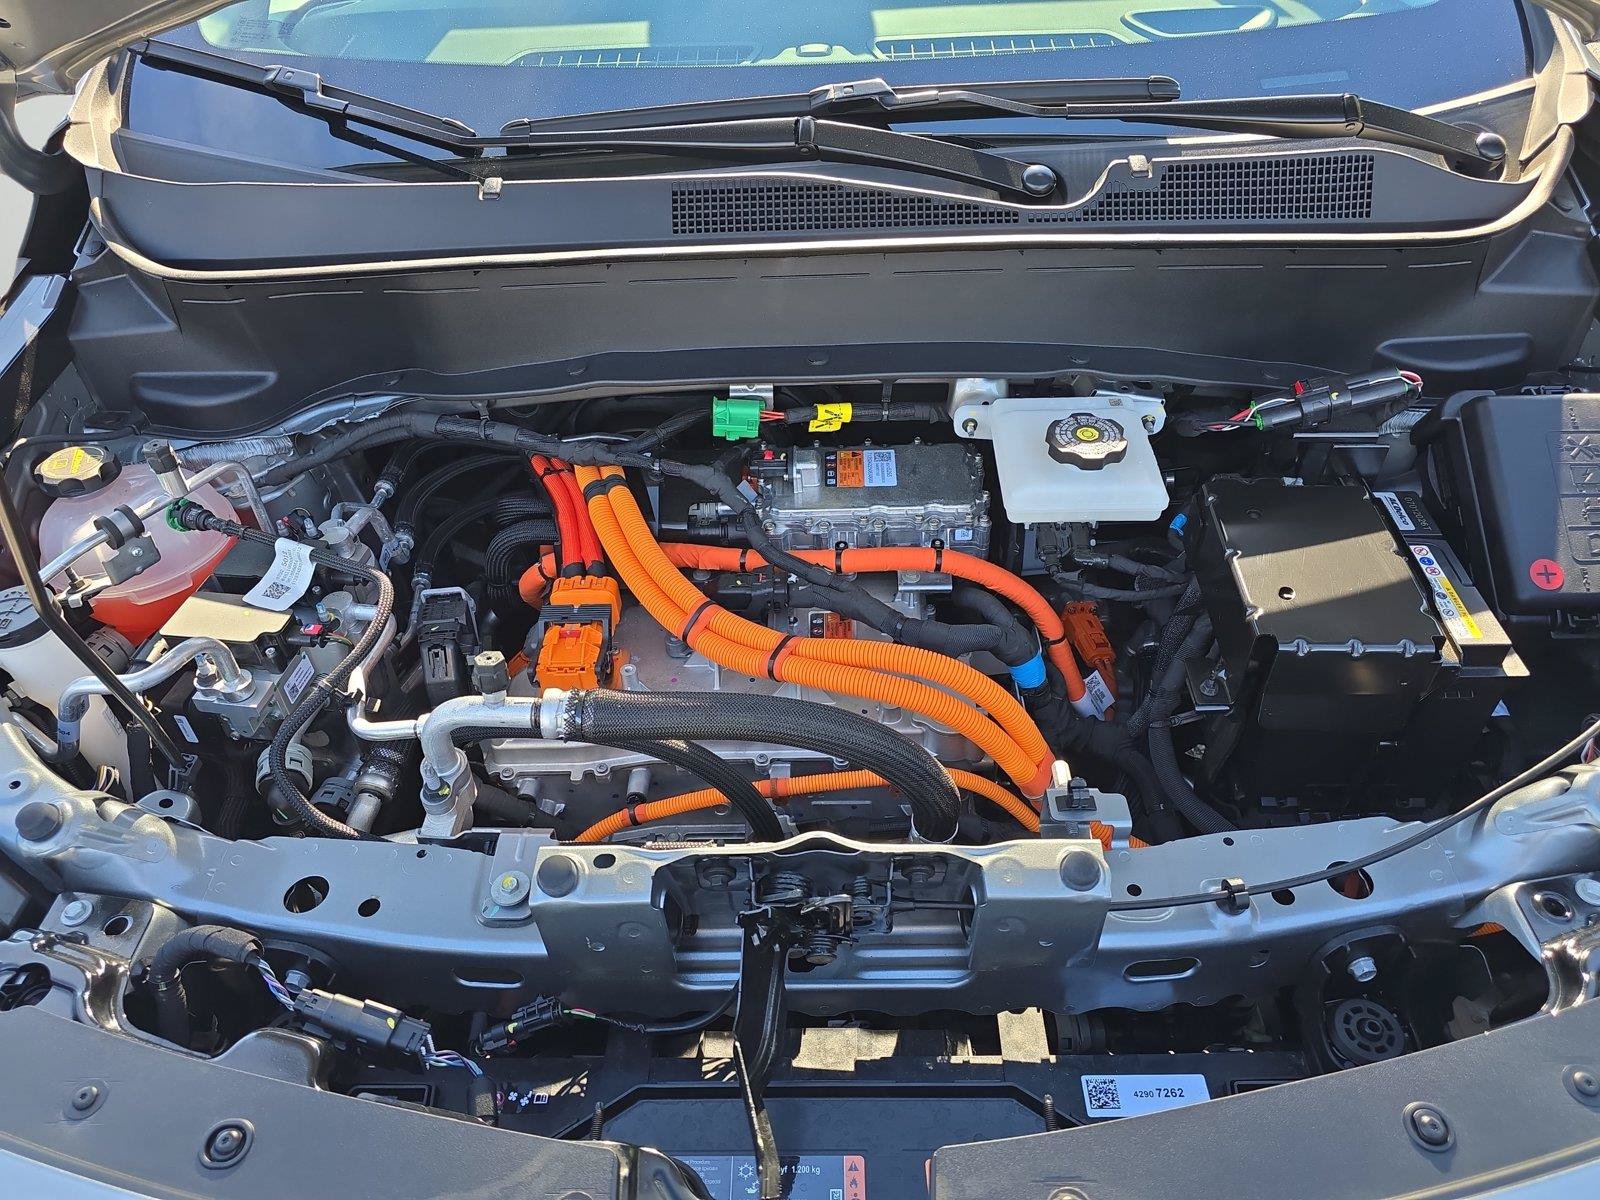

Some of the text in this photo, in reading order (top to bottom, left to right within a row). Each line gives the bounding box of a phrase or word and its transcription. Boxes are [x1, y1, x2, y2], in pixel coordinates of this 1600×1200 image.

[1388, 496, 1409, 526] ACDelco
[1133, 1087, 1185, 1098] 4290 7262
[791, 1165, 810, 1174] 1.200
[811, 1165, 821, 1176] kg
